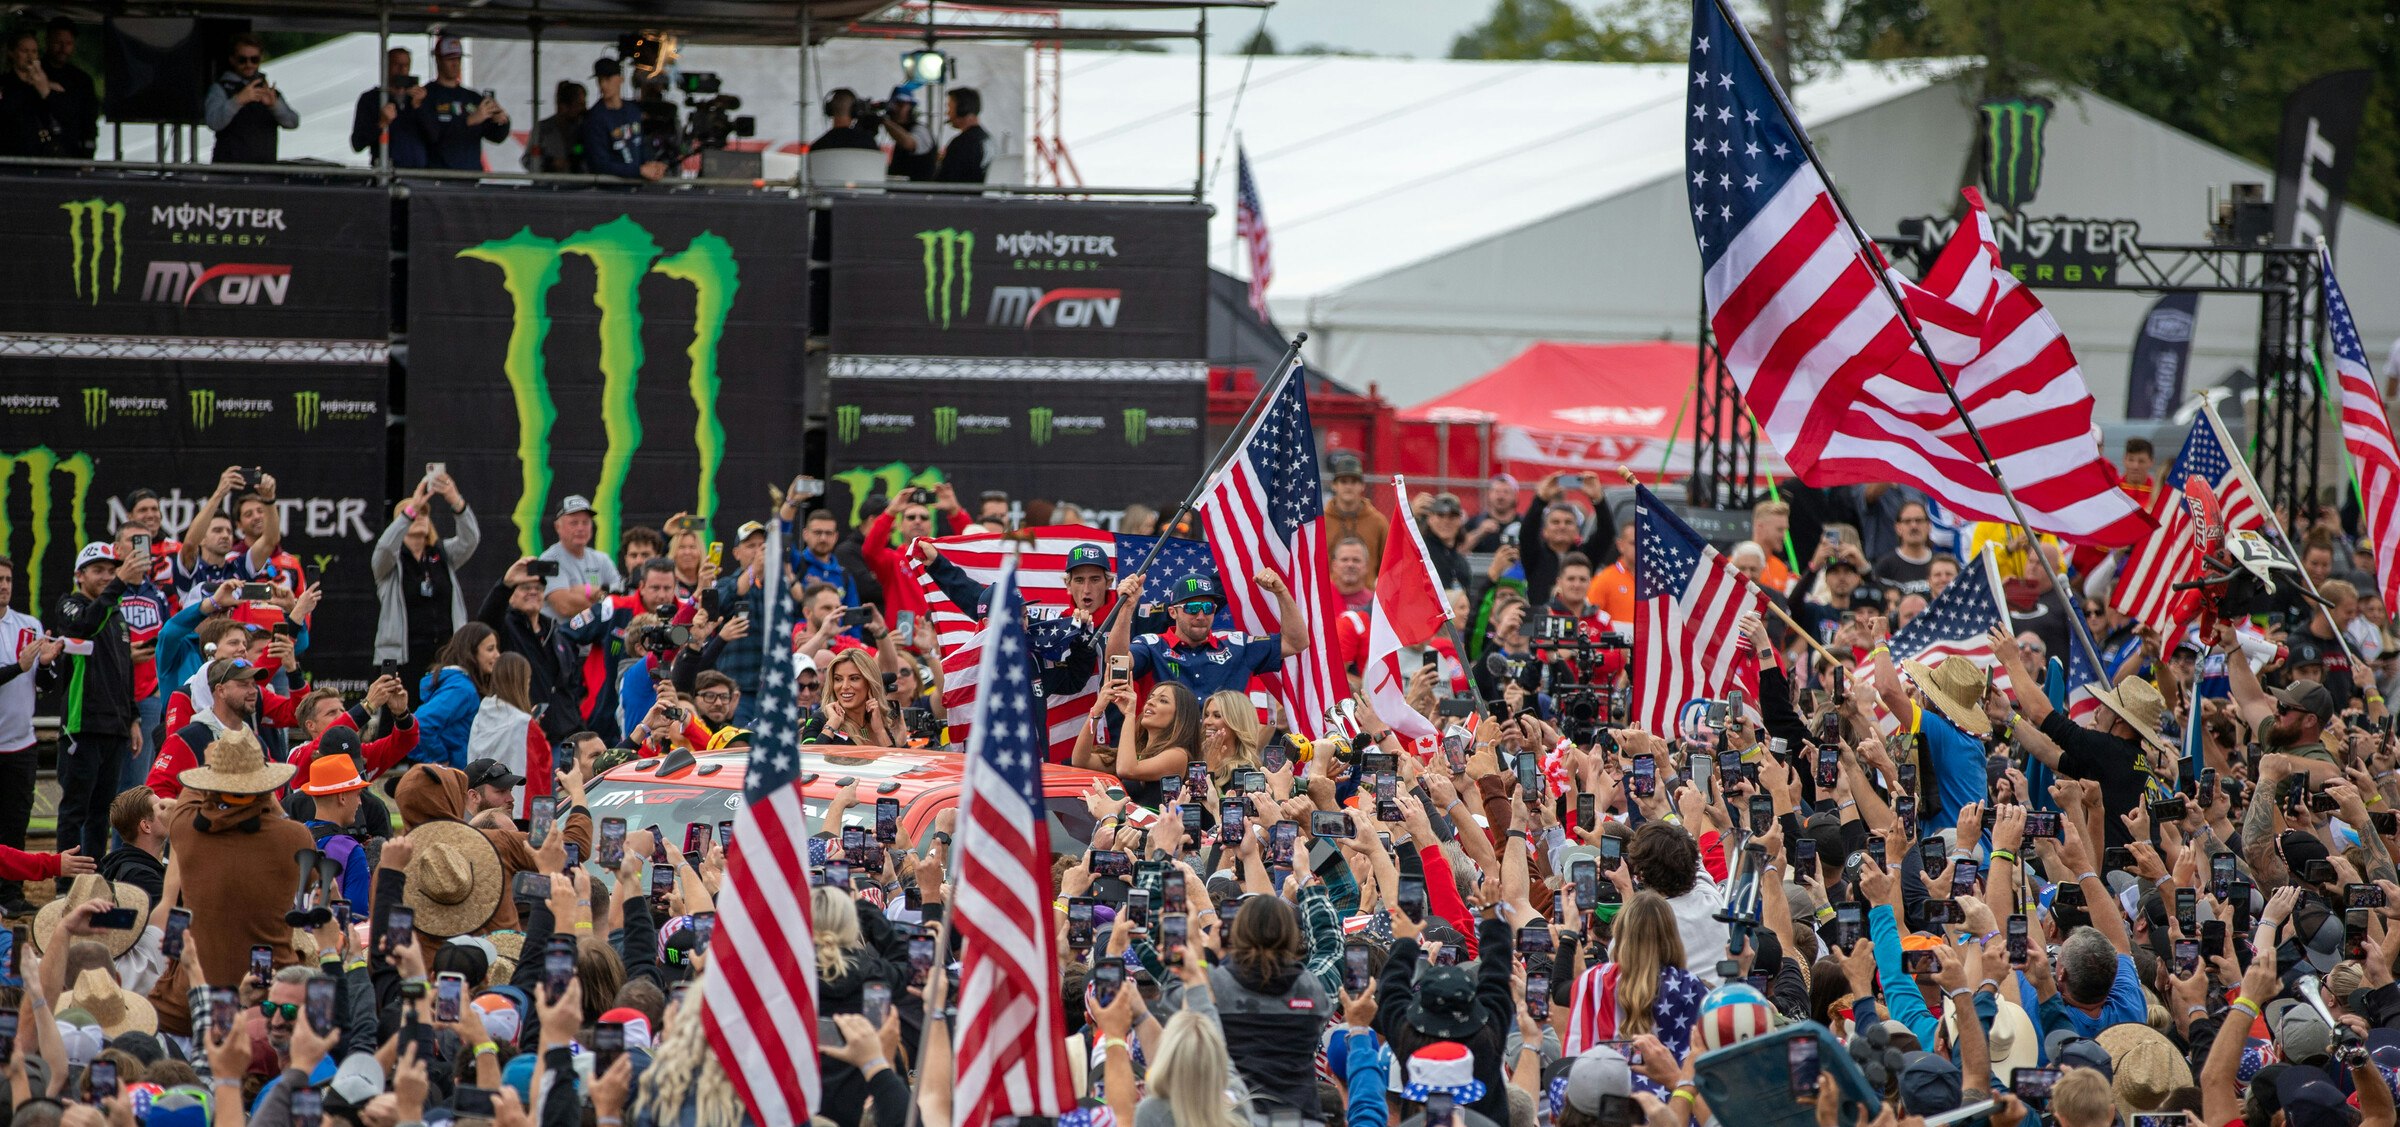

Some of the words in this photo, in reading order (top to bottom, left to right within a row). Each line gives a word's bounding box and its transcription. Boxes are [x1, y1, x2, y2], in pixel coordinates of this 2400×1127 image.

[152, 202, 287, 231] MONSTER
[172, 233, 266, 245] ENERGY
[996, 230, 1118, 258] MONSTER
[1921, 213, 2145, 259] MNSTER
[1013, 259, 1098, 271] ENERGY
[2010, 264, 2108, 282] ERGY
[120, 605, 158, 628] USA
